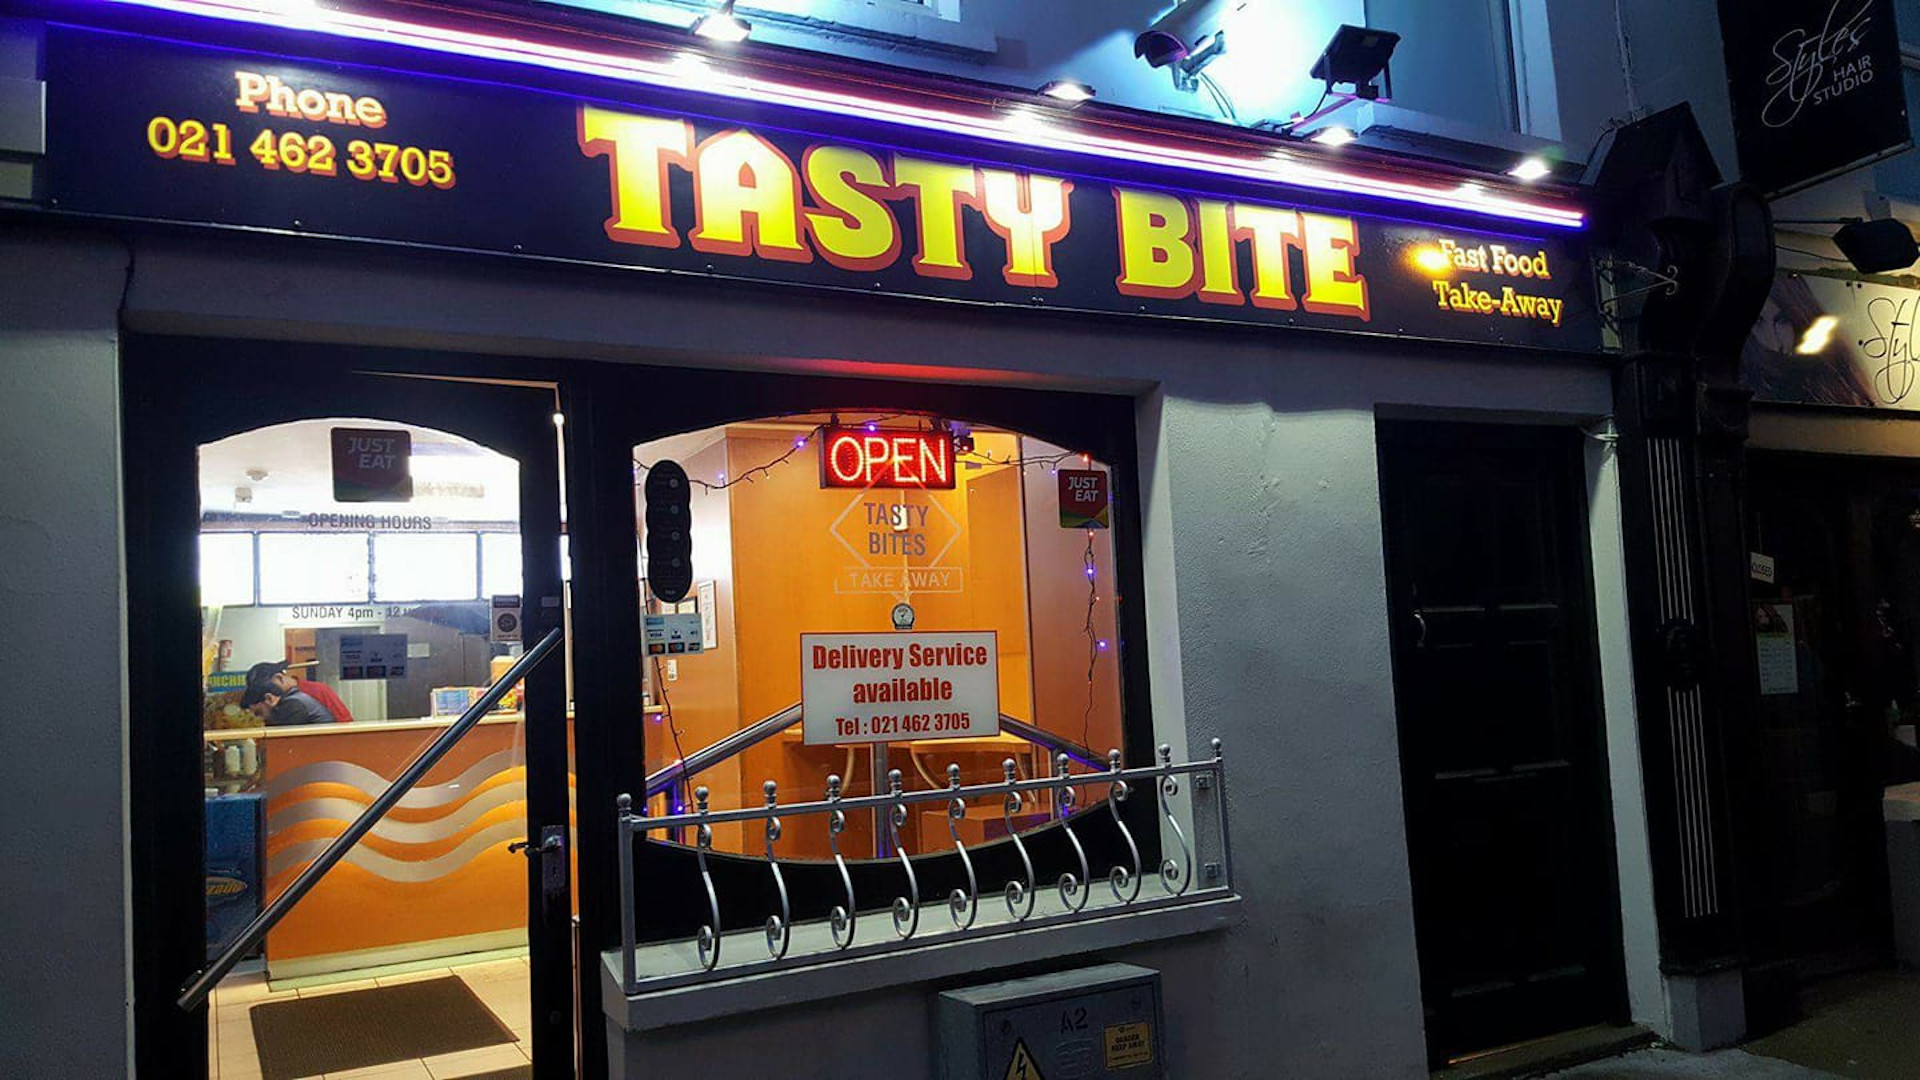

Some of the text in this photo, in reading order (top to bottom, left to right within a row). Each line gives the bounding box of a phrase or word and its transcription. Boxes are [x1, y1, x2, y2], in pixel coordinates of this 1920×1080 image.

[1833, 54, 1873, 83] HAIR
[234, 71, 387, 128] Phone
[1813, 68, 1874, 106] STUDIO
[147, 116, 456, 190] 021 462 3705
[576, 104, 1372, 322] TASTY BITE
[1438, 238, 1551, 279] Fast Food
[1432, 280, 1563, 327] Take-Away
[347, 437, 396, 454] JUST
[830, 435, 947, 481] OPEN
[359, 454, 396, 470] EAT
[1068, 476, 1099, 490] JUST
[1075, 488, 1099, 503] EAT
[308, 512, 433, 531] OPENING HOURS
[863, 501, 930, 528] TASTY
[868, 532, 927, 557] BITES
[848, 570, 951, 589] TAKE AWAY
[292, 606, 343, 619] SUNDAY
[348, 607, 374, 621] 4pm
[812, 641, 988, 671] Delivery Service
[853, 676, 953, 705] available
[836, 717, 859, 736] Tel
[871, 715, 898, 734] 021
[902, 714, 930, 732] 462
[934, 712, 970, 731] 3705
